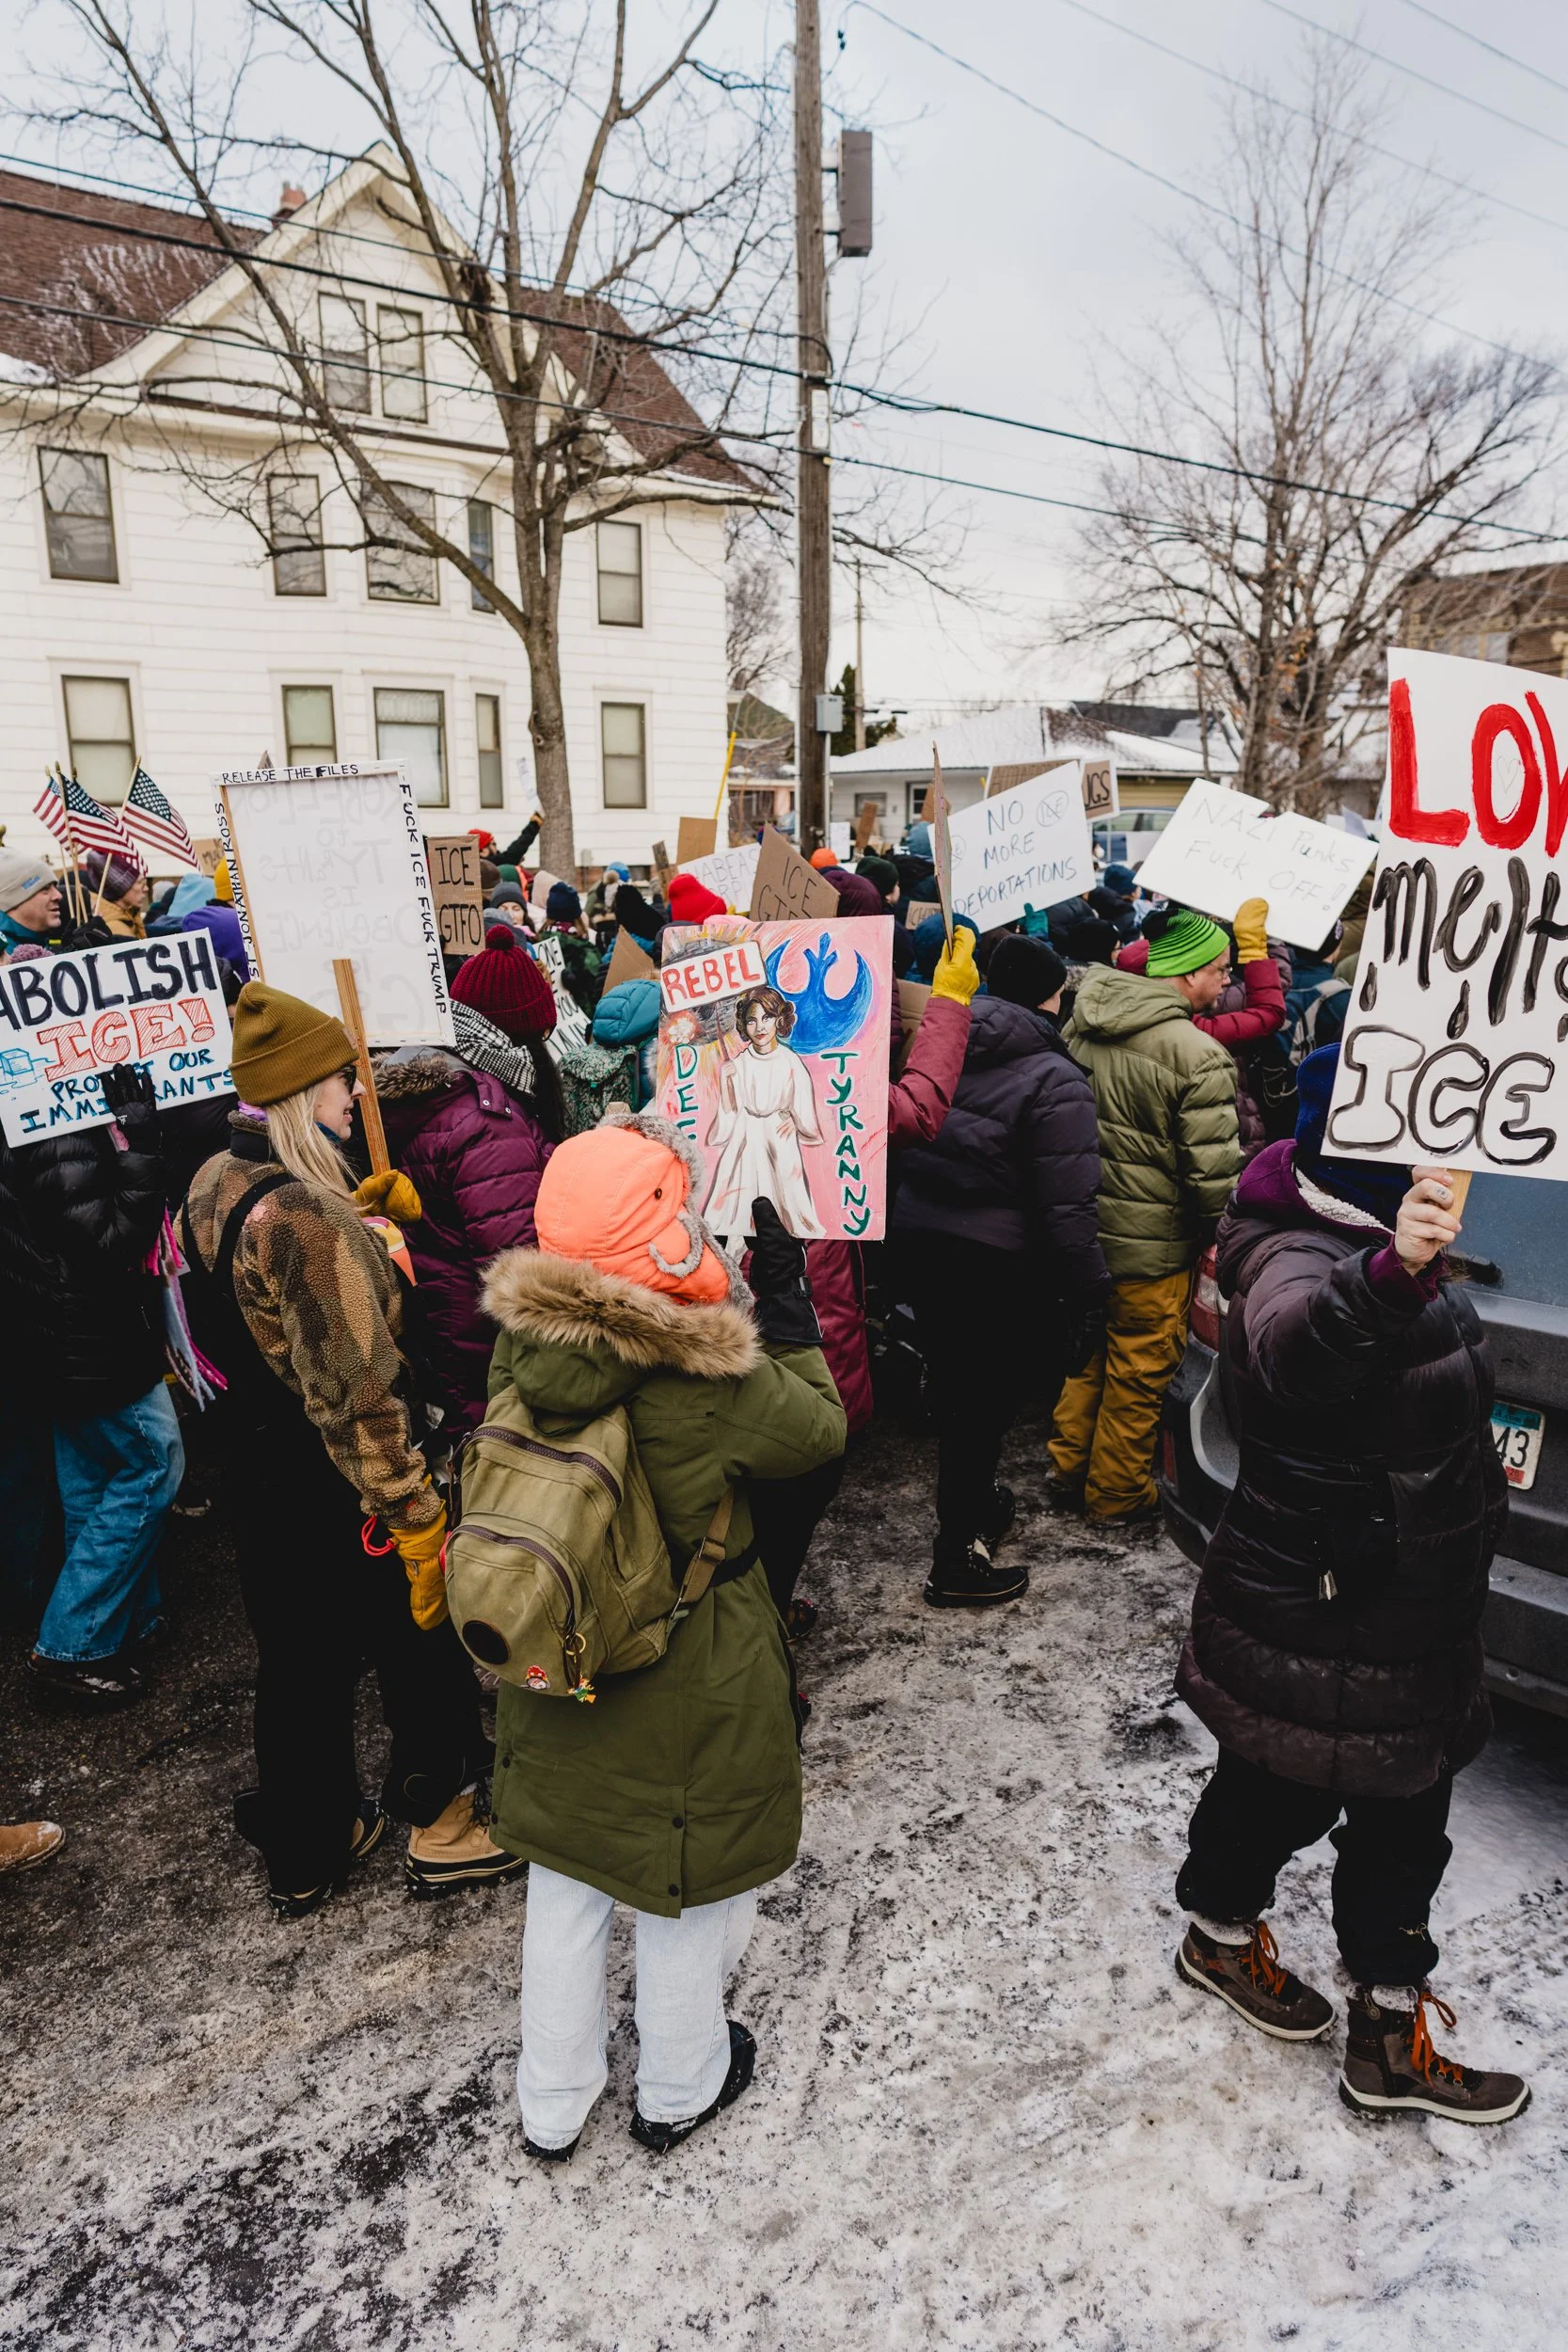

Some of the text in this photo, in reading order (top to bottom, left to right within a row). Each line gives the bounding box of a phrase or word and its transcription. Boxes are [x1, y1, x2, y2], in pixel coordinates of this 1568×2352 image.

[222, 764, 358, 784] RELEASE THE FILES
[1389, 677, 1568, 858] LOV
[215, 803, 234, 851] ROSS
[988, 801, 1023, 834] NO
[435, 847, 474, 885] ICE
[984, 832, 1035, 868] MORE
[227, 859, 252, 944] JONATHAN
[399, 783, 447, 1014] FUCK ICE FUCK TRUMP
[783, 855, 816, 919] ICE
[954, 857, 1077, 915] DEPORTATIONS
[438, 904, 481, 946] GTFO
[661, 949, 761, 1006] REBEL
[37, 997, 215, 1082] ICE!
[169, 1048, 214, 1072] OUR
[1326, 1025, 1558, 1167] ICE
[819, 1053, 872, 1238] TYRANNY
